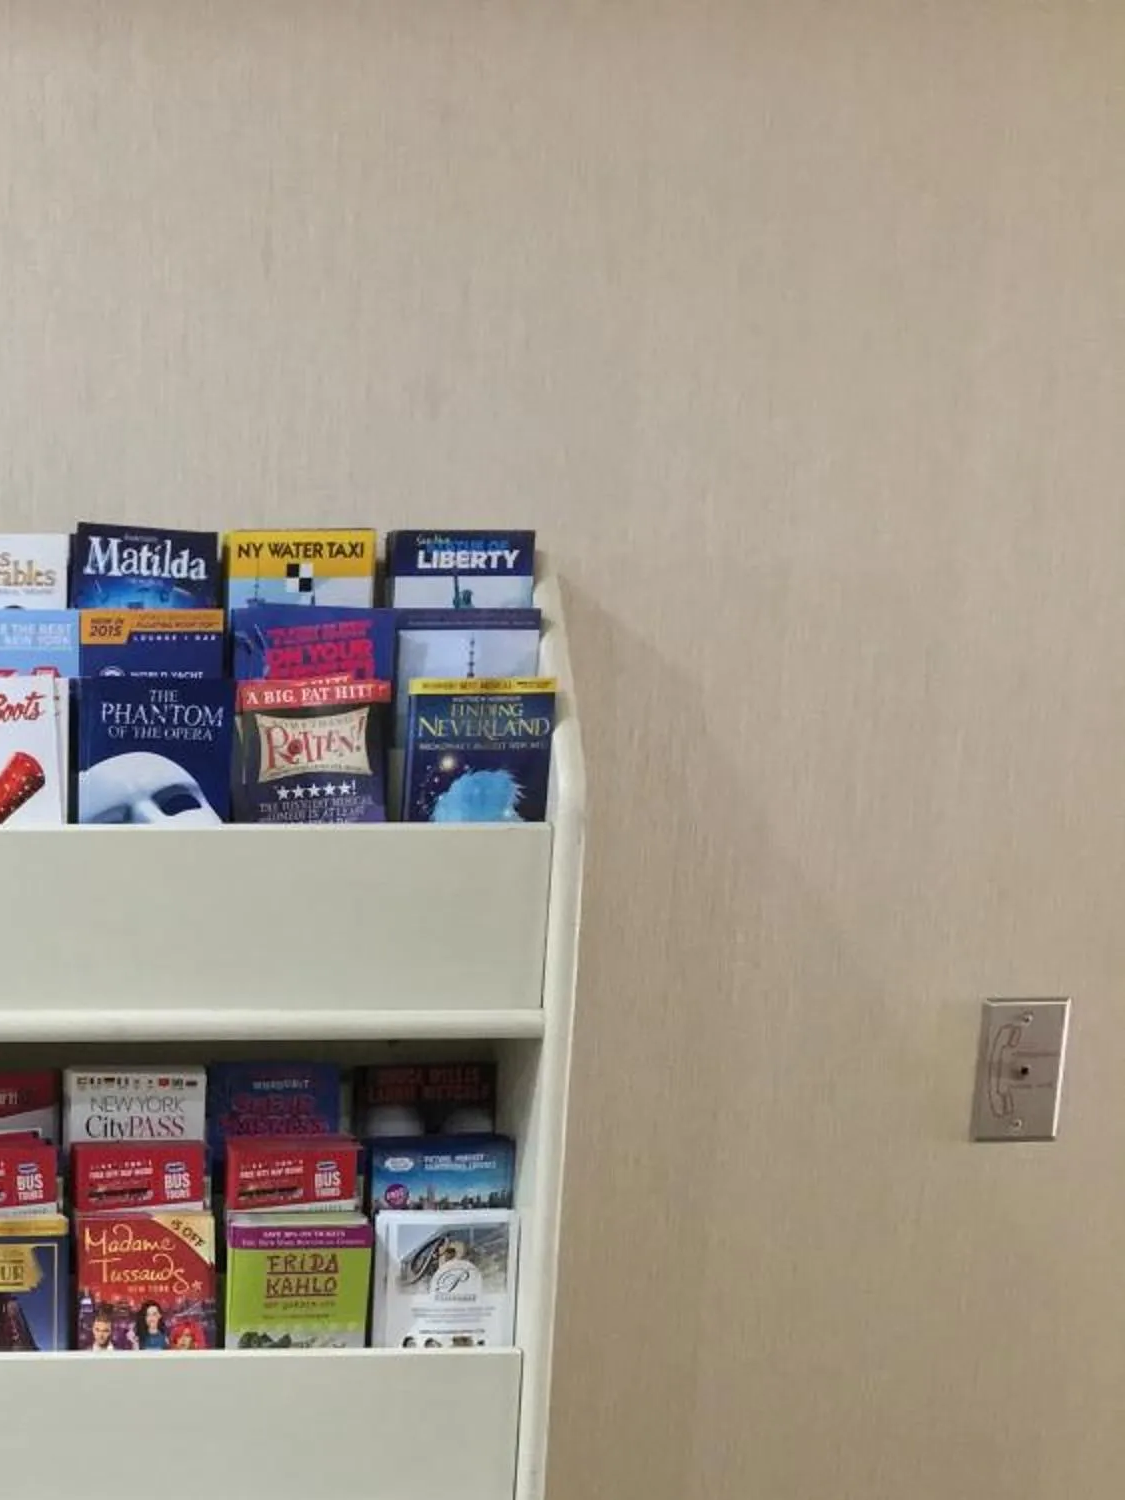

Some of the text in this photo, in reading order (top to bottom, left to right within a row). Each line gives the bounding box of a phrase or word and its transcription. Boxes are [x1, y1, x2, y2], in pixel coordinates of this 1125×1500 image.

[83, 535, 208, 581] Matilda
[238, 542, 364, 559] NY WATER TAXI
[417, 550, 520, 569] LIBERTY
[149, 689, 179, 701] THE
[247, 692, 258, 704] A
[302, 688, 329, 700] FAT
[101, 703, 224, 727] PHANTOM
[451, 703, 524, 717] FINDING
[108, 726, 213, 741] OF THE OPERA
[418, 715, 550, 740] NEVERLAND
[266, 716, 365, 769] ROTTEN!
[91, 1096, 185, 1111] NEW YORK
[85, 1116, 185, 1141] CityPASS
[16, 1173, 44, 1189] BUS
[164, 1173, 191, 1189] BUS
[314, 1172, 341, 1189] BUS
[85, 1224, 175, 1257] Madame
[180, 1226, 205, 1248] OFF
[267, 1253, 339, 1272] FRIDA
[89, 1255, 190, 1294] Tussauds
[267, 1276, 337, 1295] KAHLO
